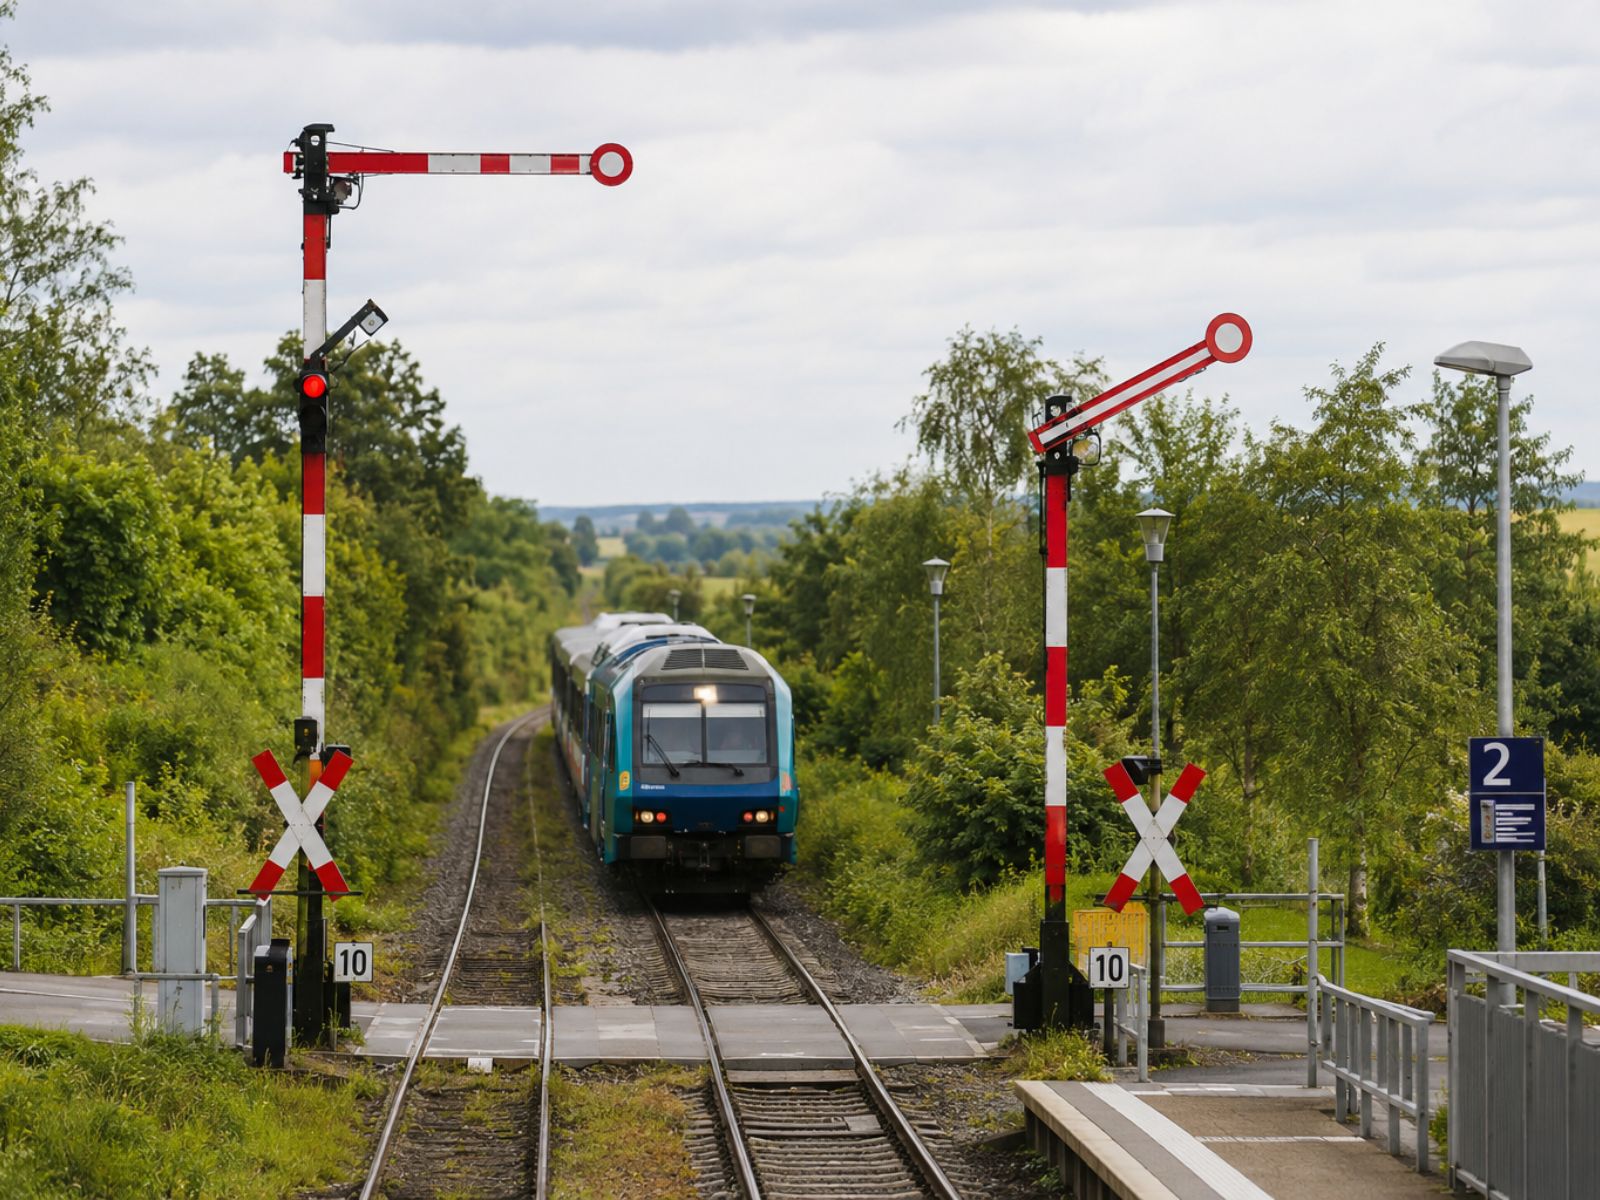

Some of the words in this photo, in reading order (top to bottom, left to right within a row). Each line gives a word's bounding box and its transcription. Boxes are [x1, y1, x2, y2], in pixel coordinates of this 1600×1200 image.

[1483, 742, 1511, 786] 2
[340, 949, 367, 976] 10
[1096, 954, 1123, 982] 10
